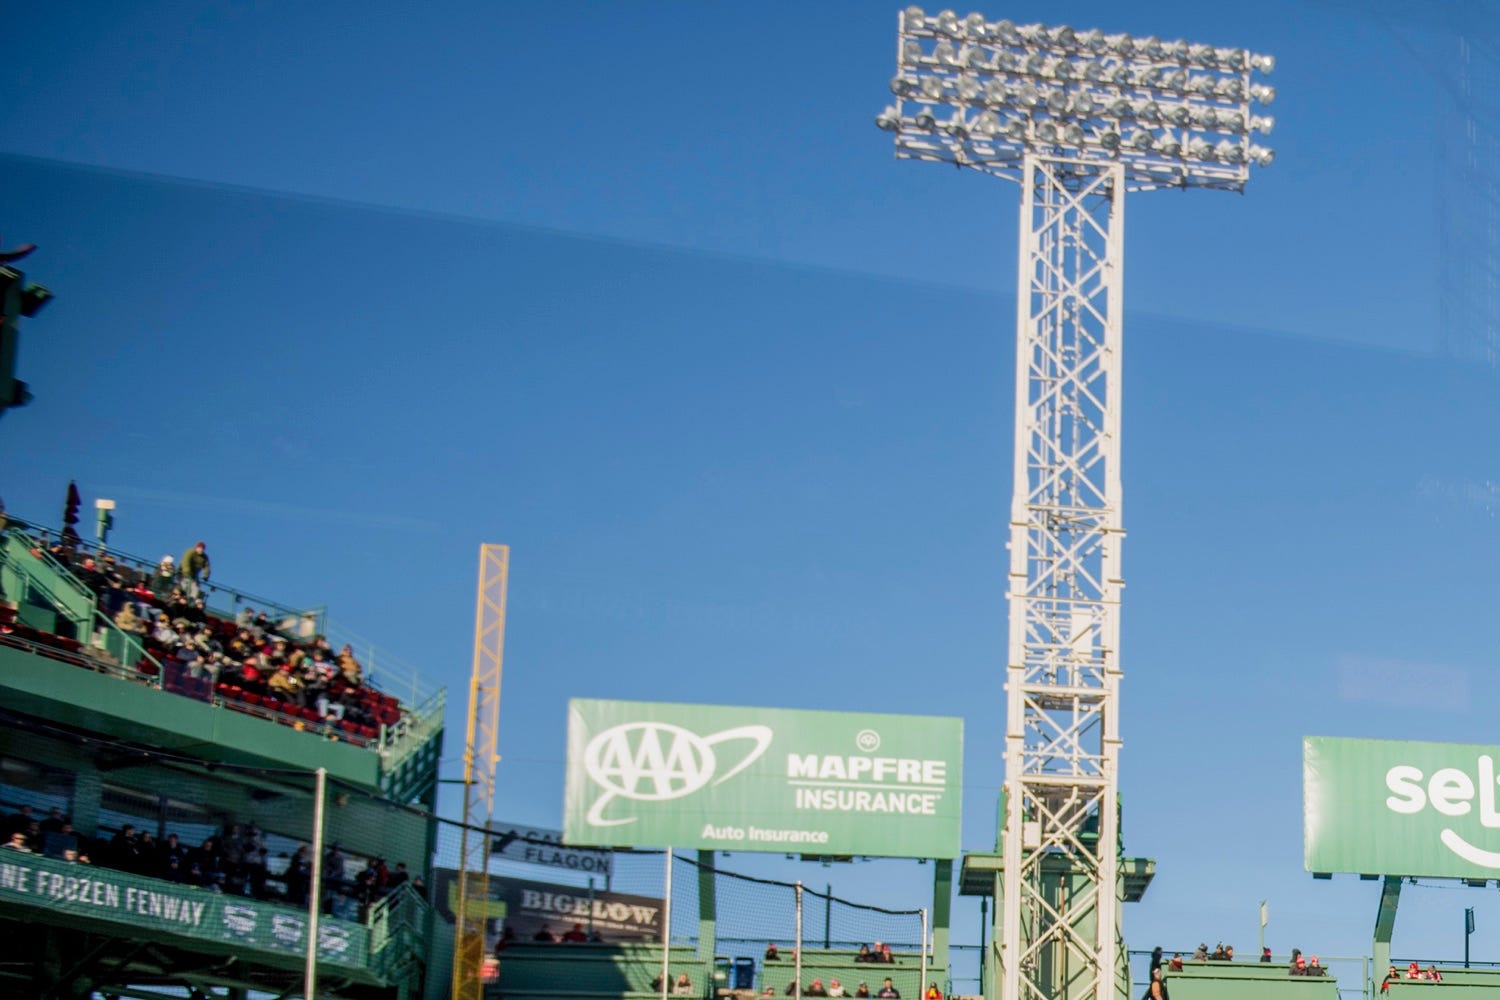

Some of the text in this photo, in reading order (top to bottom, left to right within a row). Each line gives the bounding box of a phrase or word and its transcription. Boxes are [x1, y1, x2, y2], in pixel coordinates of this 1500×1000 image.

[787, 754, 946, 784] MAPFRE
[796, 790, 936, 815] INSURANCE
[702, 824, 829, 843] Auto Insurance
[525, 849, 609, 871] FLAGON
[36, 871, 119, 907] FROZEN
[126, 888, 205, 925] FENWAY
[520, 889, 659, 925] BIGELOW
